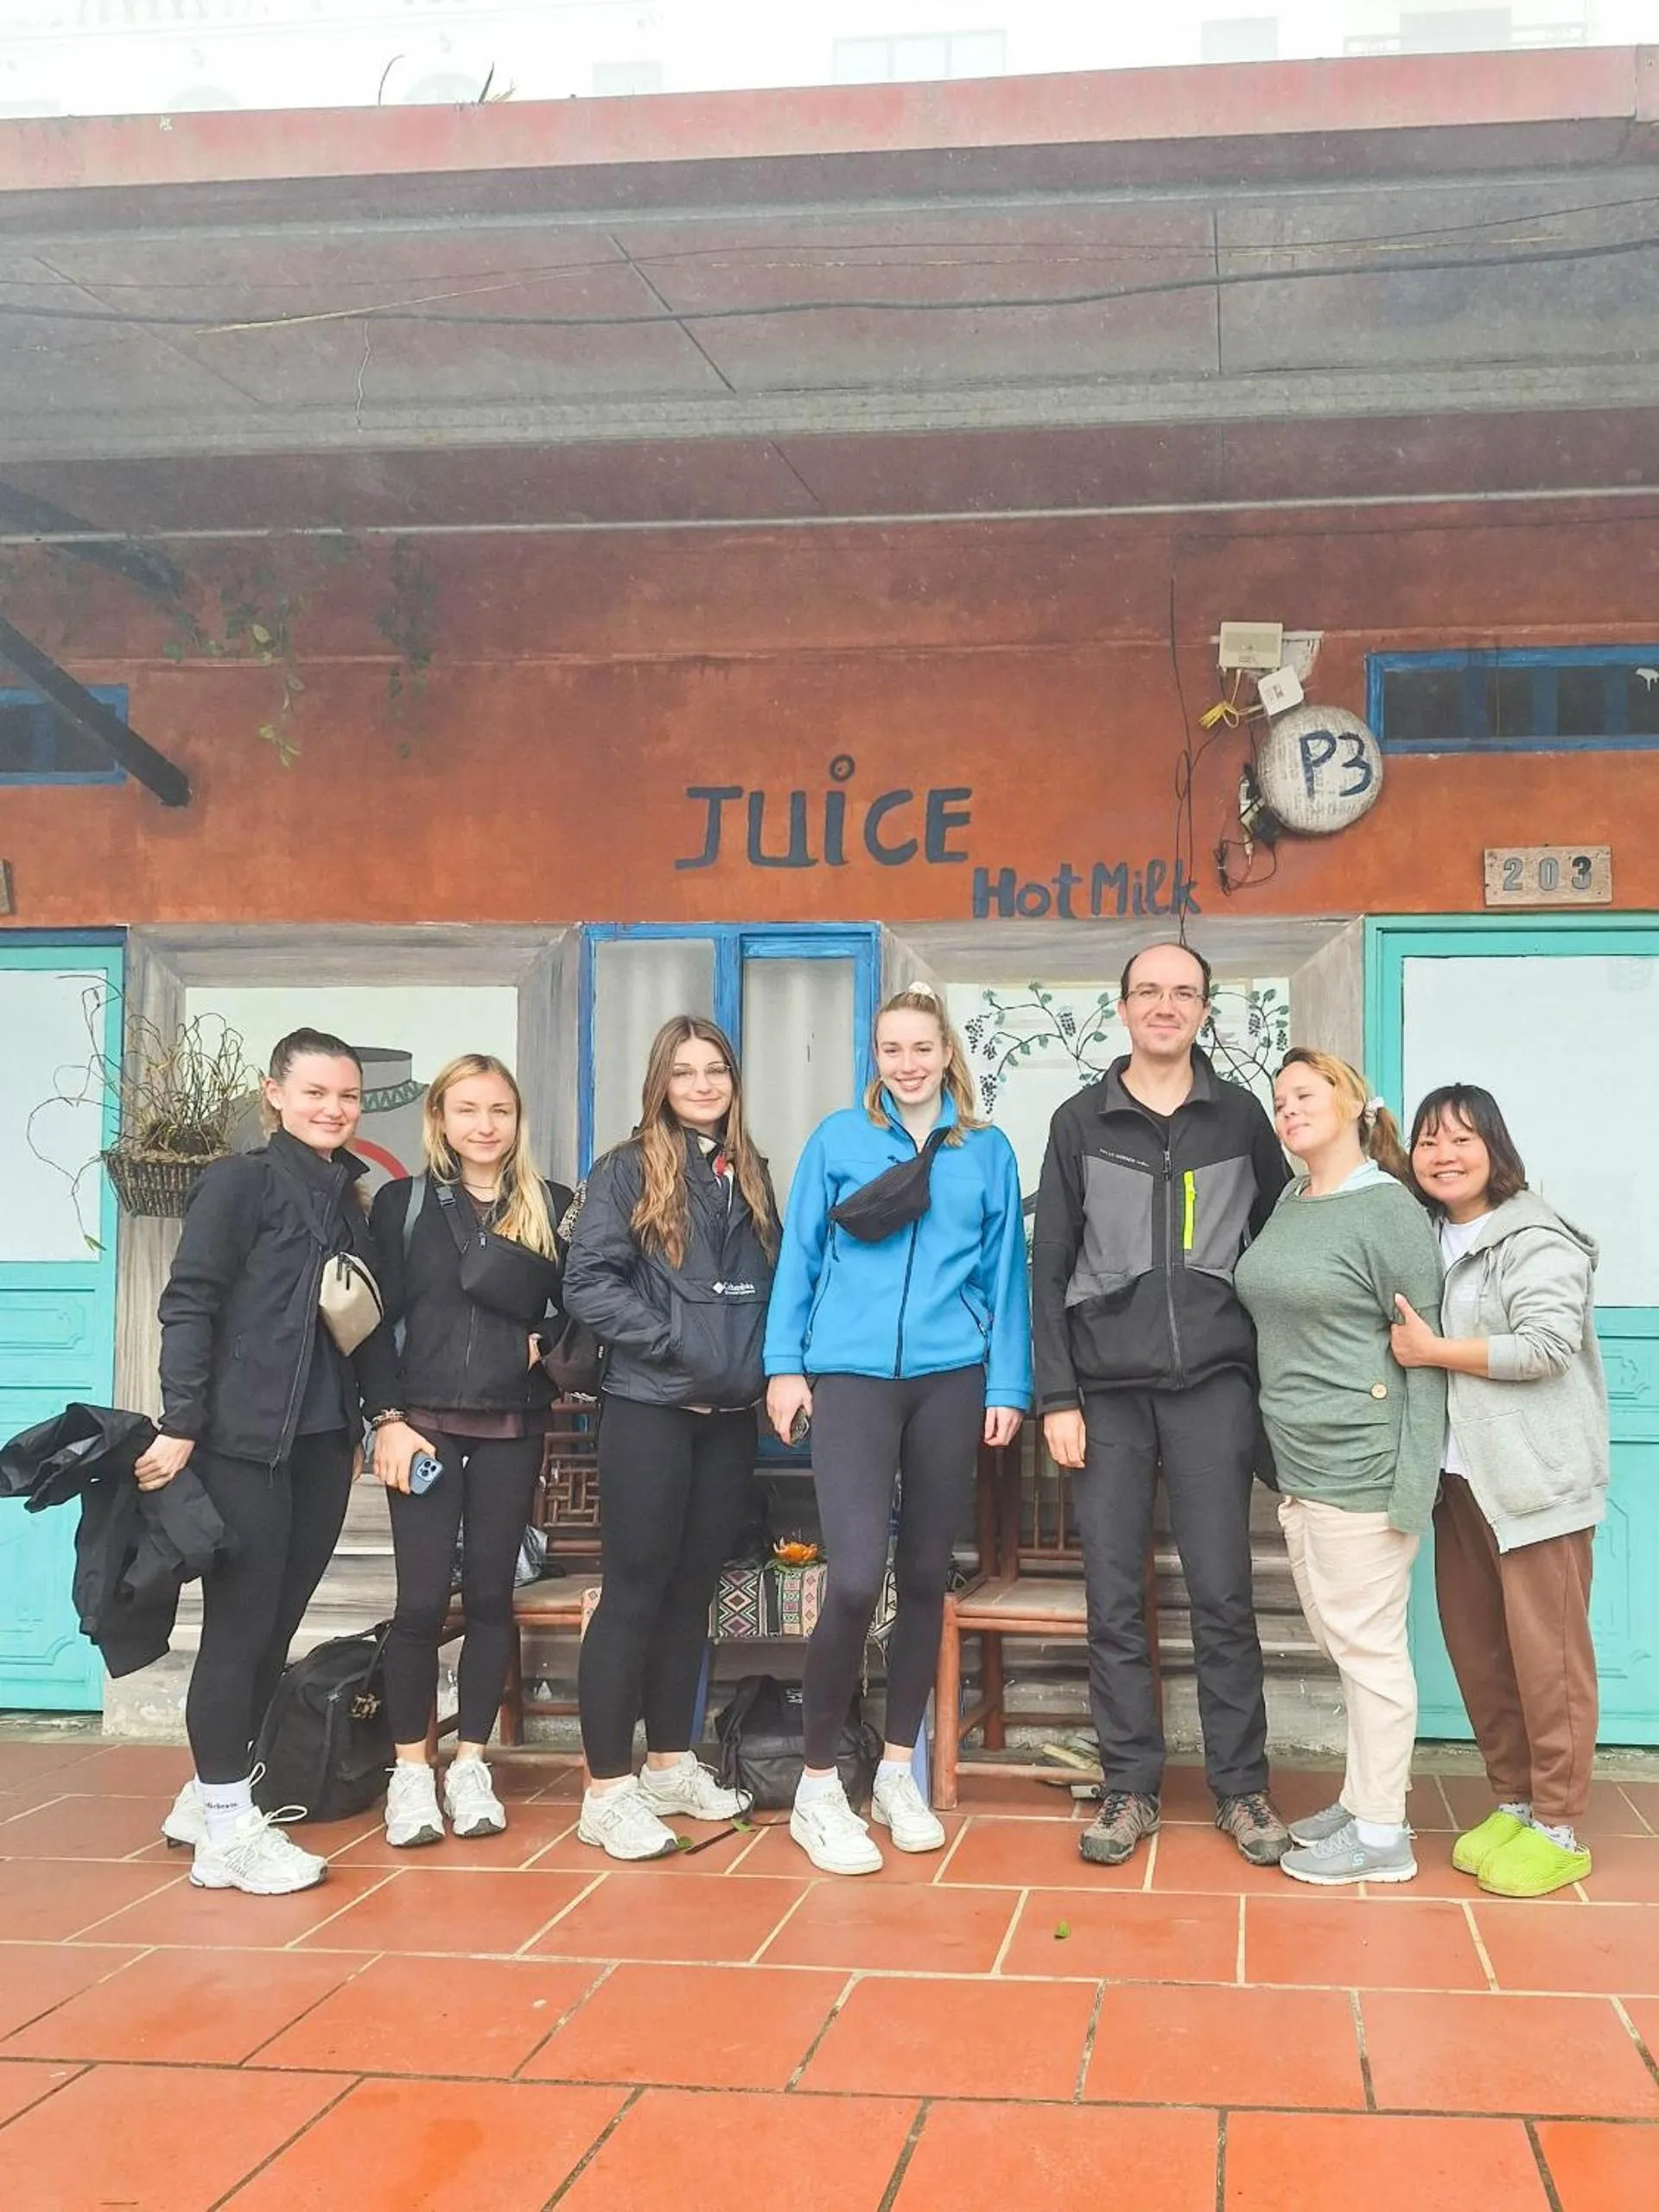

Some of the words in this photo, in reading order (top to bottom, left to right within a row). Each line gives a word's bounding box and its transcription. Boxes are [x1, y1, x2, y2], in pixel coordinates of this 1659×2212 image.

[1300, 729, 1373, 799] P3
[973, 862, 1083, 919] Hot
[1091, 858, 1201, 915] Milk
[1503, 855, 1592, 891] 203
